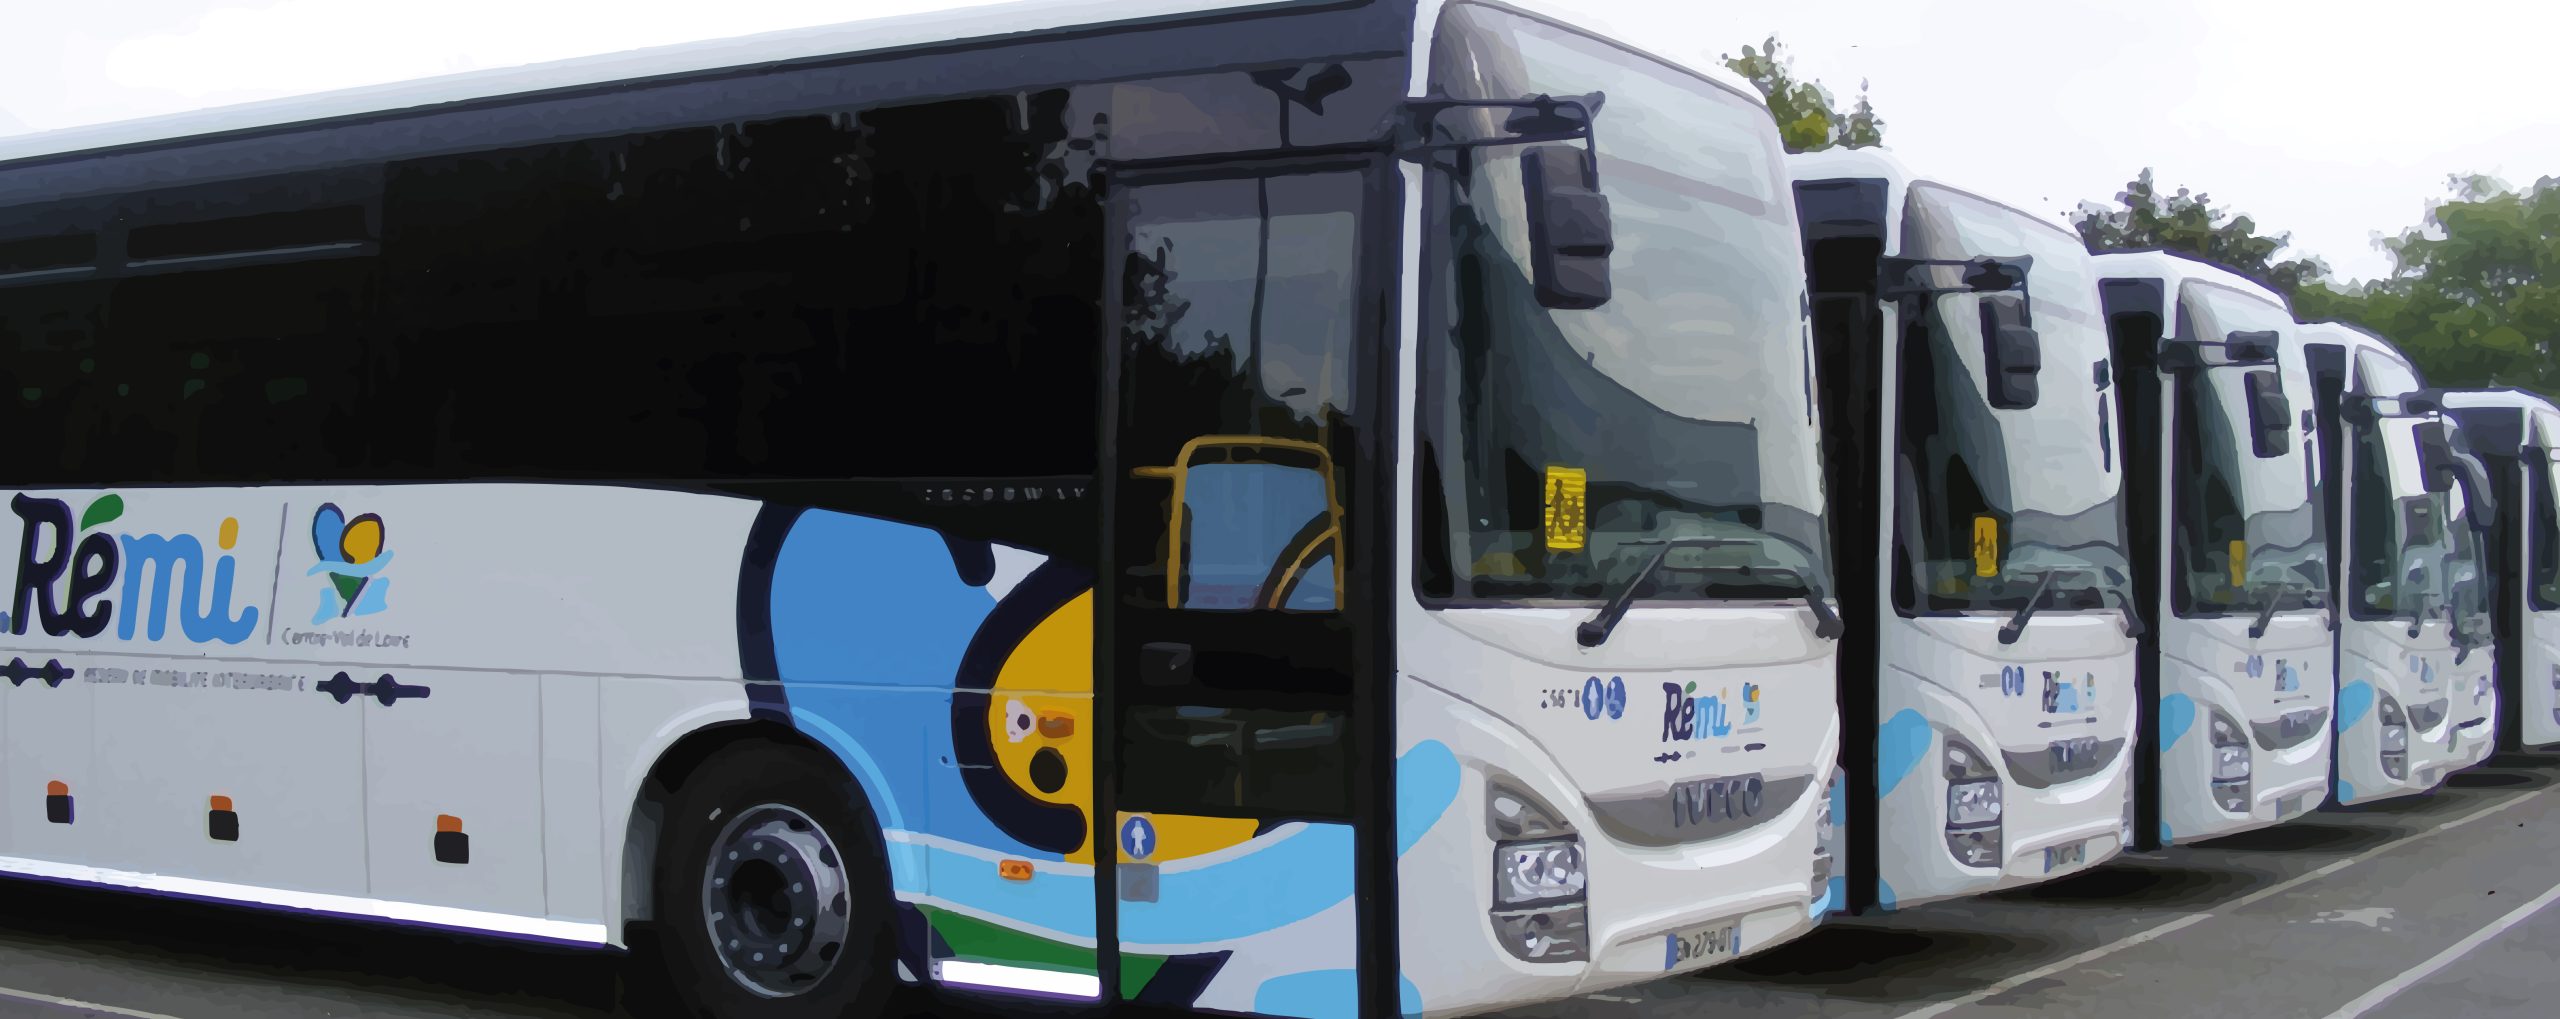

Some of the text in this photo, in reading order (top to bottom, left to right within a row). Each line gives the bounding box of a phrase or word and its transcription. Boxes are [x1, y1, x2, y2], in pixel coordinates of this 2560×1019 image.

[11, 492, 259, 645] Rémi
[1662, 681, 1732, 742] Rémi
[1673, 777, 1764, 828] IVECO
